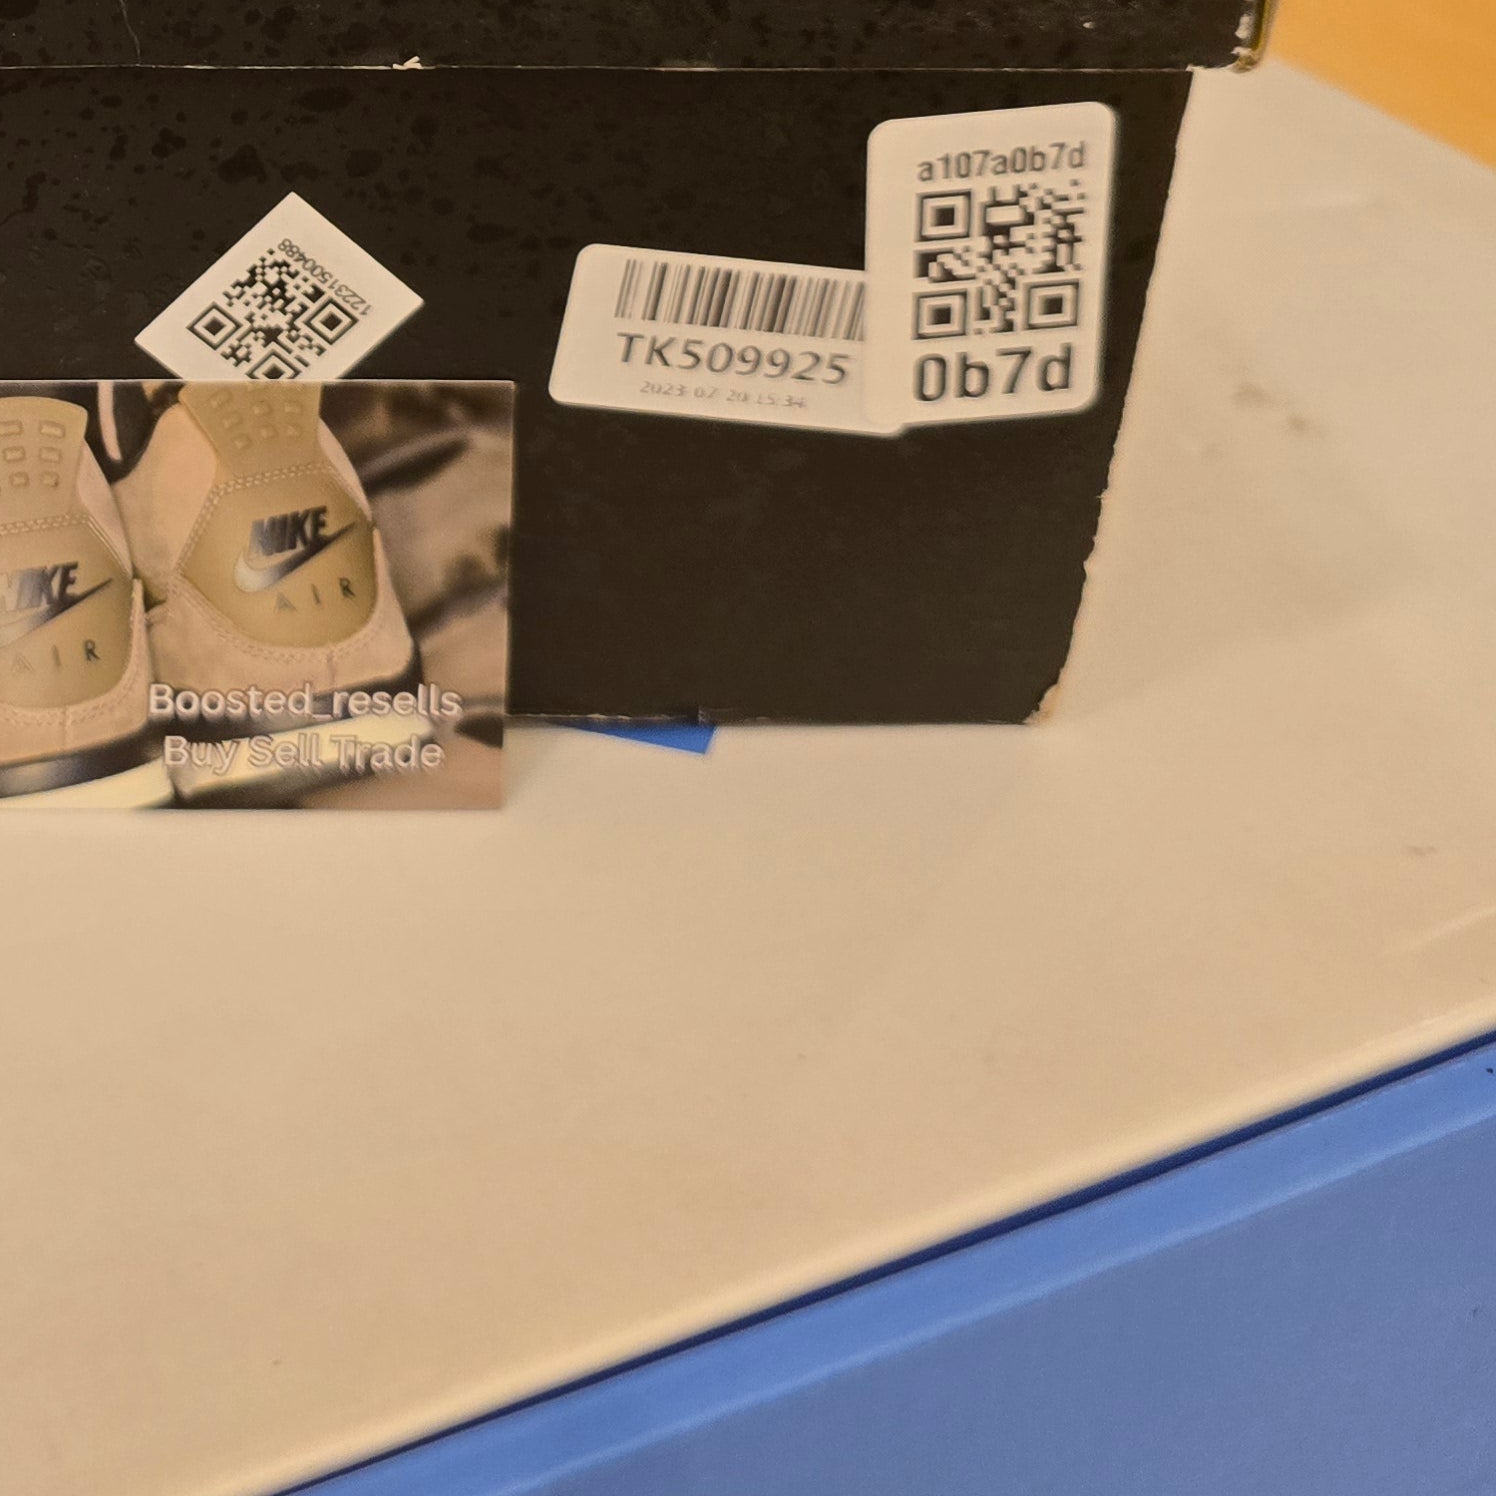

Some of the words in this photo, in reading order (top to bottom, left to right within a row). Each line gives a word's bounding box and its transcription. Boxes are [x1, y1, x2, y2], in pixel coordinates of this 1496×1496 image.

[917, 141, 1086, 181] a107a0b7d
[277, 238, 373, 316] 12231500488
[617, 332, 850, 385] TK509925
[915, 342, 1073, 402] 0b7d
[248, 505, 328, 558] NIKE
[273, 577, 356, 614] AIR
[148, 681, 464, 722] Boosted_resells
[163, 734, 239, 776] Buy
[247, 733, 323, 769] Sell
[330, 734, 446, 769] Trade
